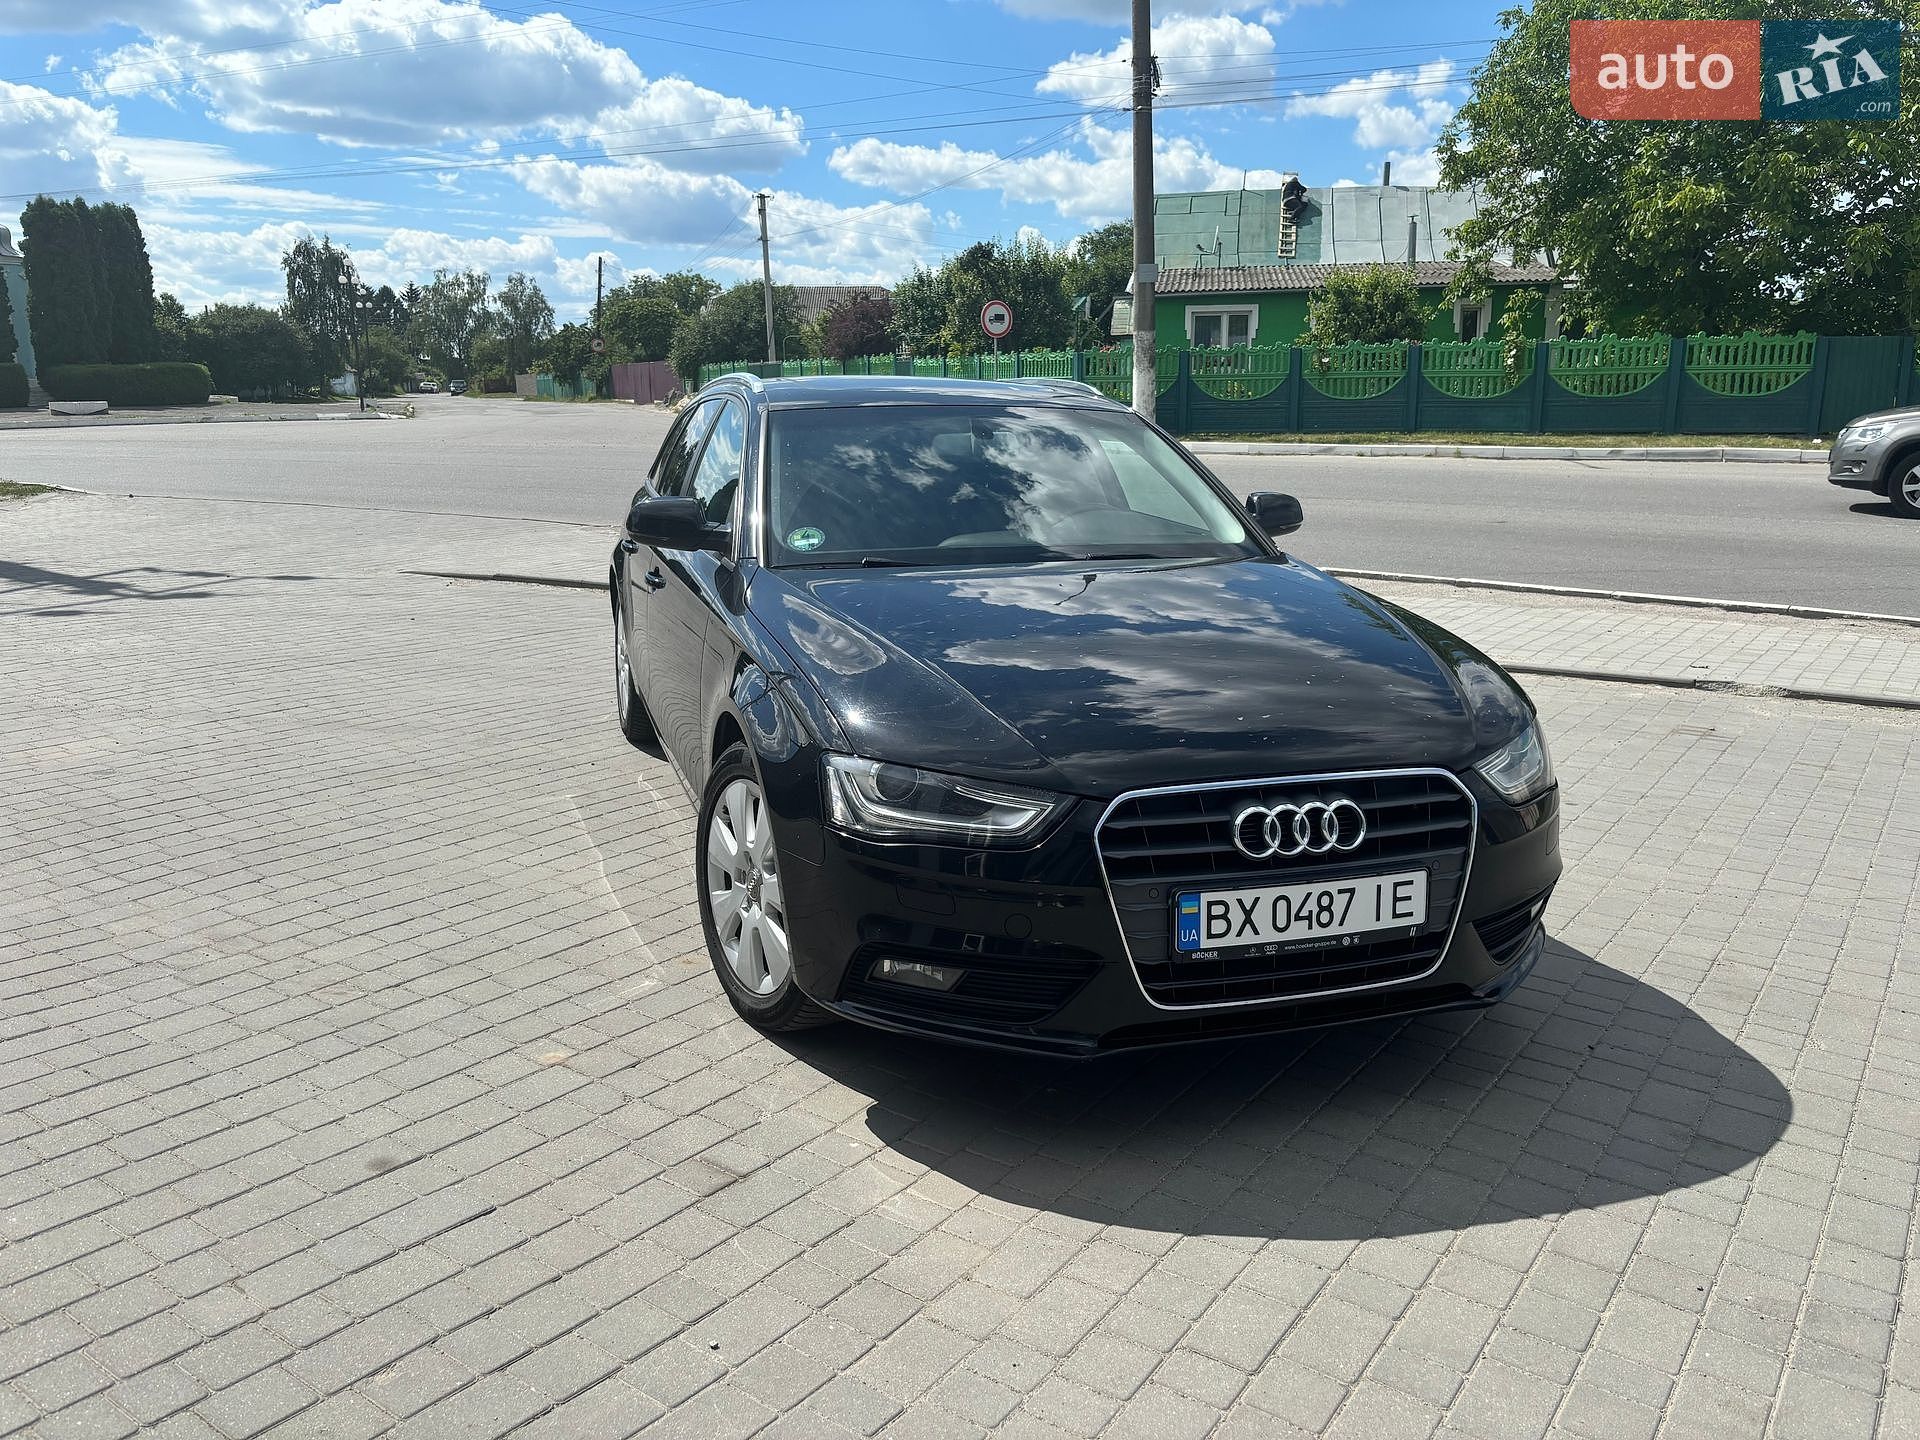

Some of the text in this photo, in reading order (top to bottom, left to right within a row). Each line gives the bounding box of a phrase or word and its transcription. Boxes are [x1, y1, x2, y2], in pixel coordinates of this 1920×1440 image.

[1206, 880, 1415, 940] BX 0487 IE
[1181, 929, 1198, 941] UA
